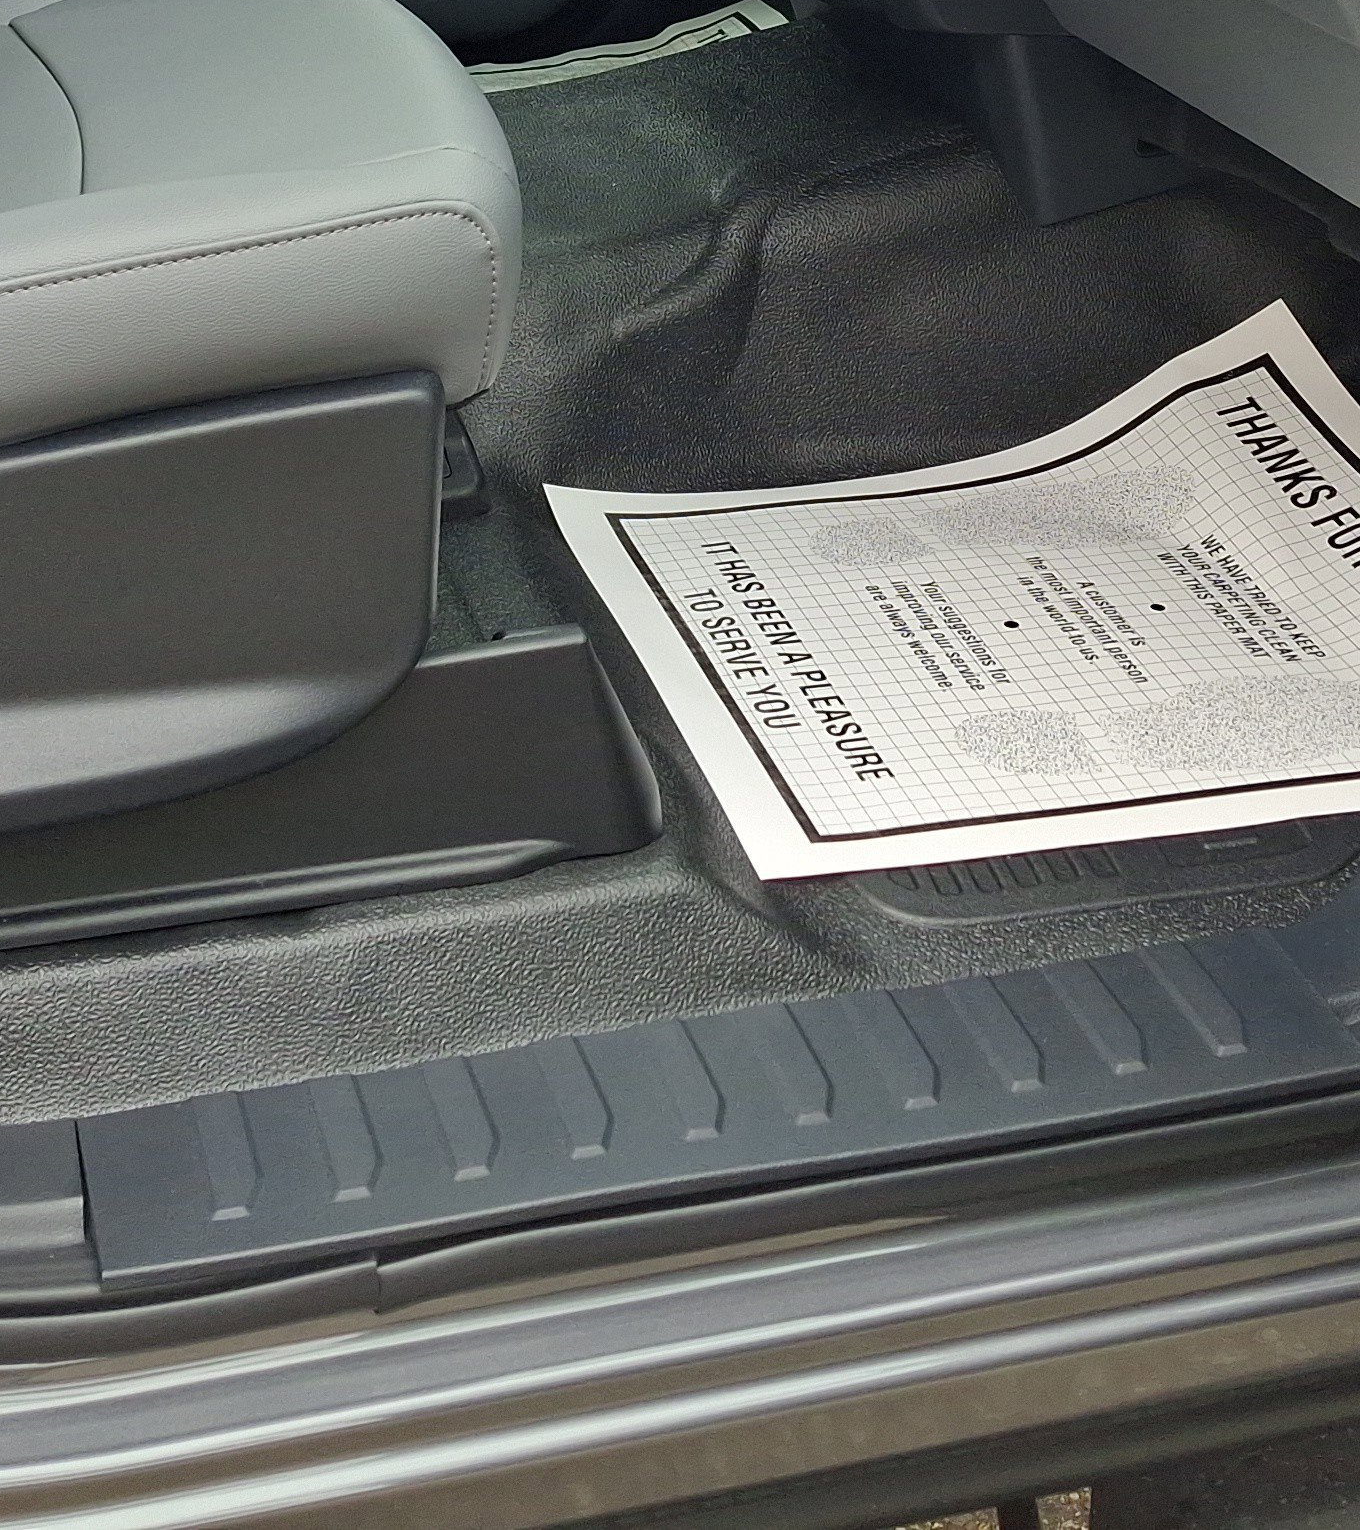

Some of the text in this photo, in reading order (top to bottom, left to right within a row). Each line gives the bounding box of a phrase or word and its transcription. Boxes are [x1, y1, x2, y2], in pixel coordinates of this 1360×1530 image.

[1216, 396, 1338, 510] THANKS
[865, 584, 953, 692] are always welcome.
[891, 580, 986, 691] improving our service
[921, 581, 1011, 685] Your suggestions for
[1017, 576, 1100, 664] in the world to us.
[1026, 556, 1149, 684] the most important person
[1076, 580, 1146, 647] A customer is
[1157, 552, 1273, 659] WITH THIS PAPER MAT
[1177, 544, 1302, 663] YOUR CARPETING CLEAN
[1201, 534, 1326, 659] WE HAVE TRIED TO KEEP
[684, 588, 802, 730] TO SERVE YOU
[701, 541, 896, 782] IT HAS BEEN A PLEASURE
